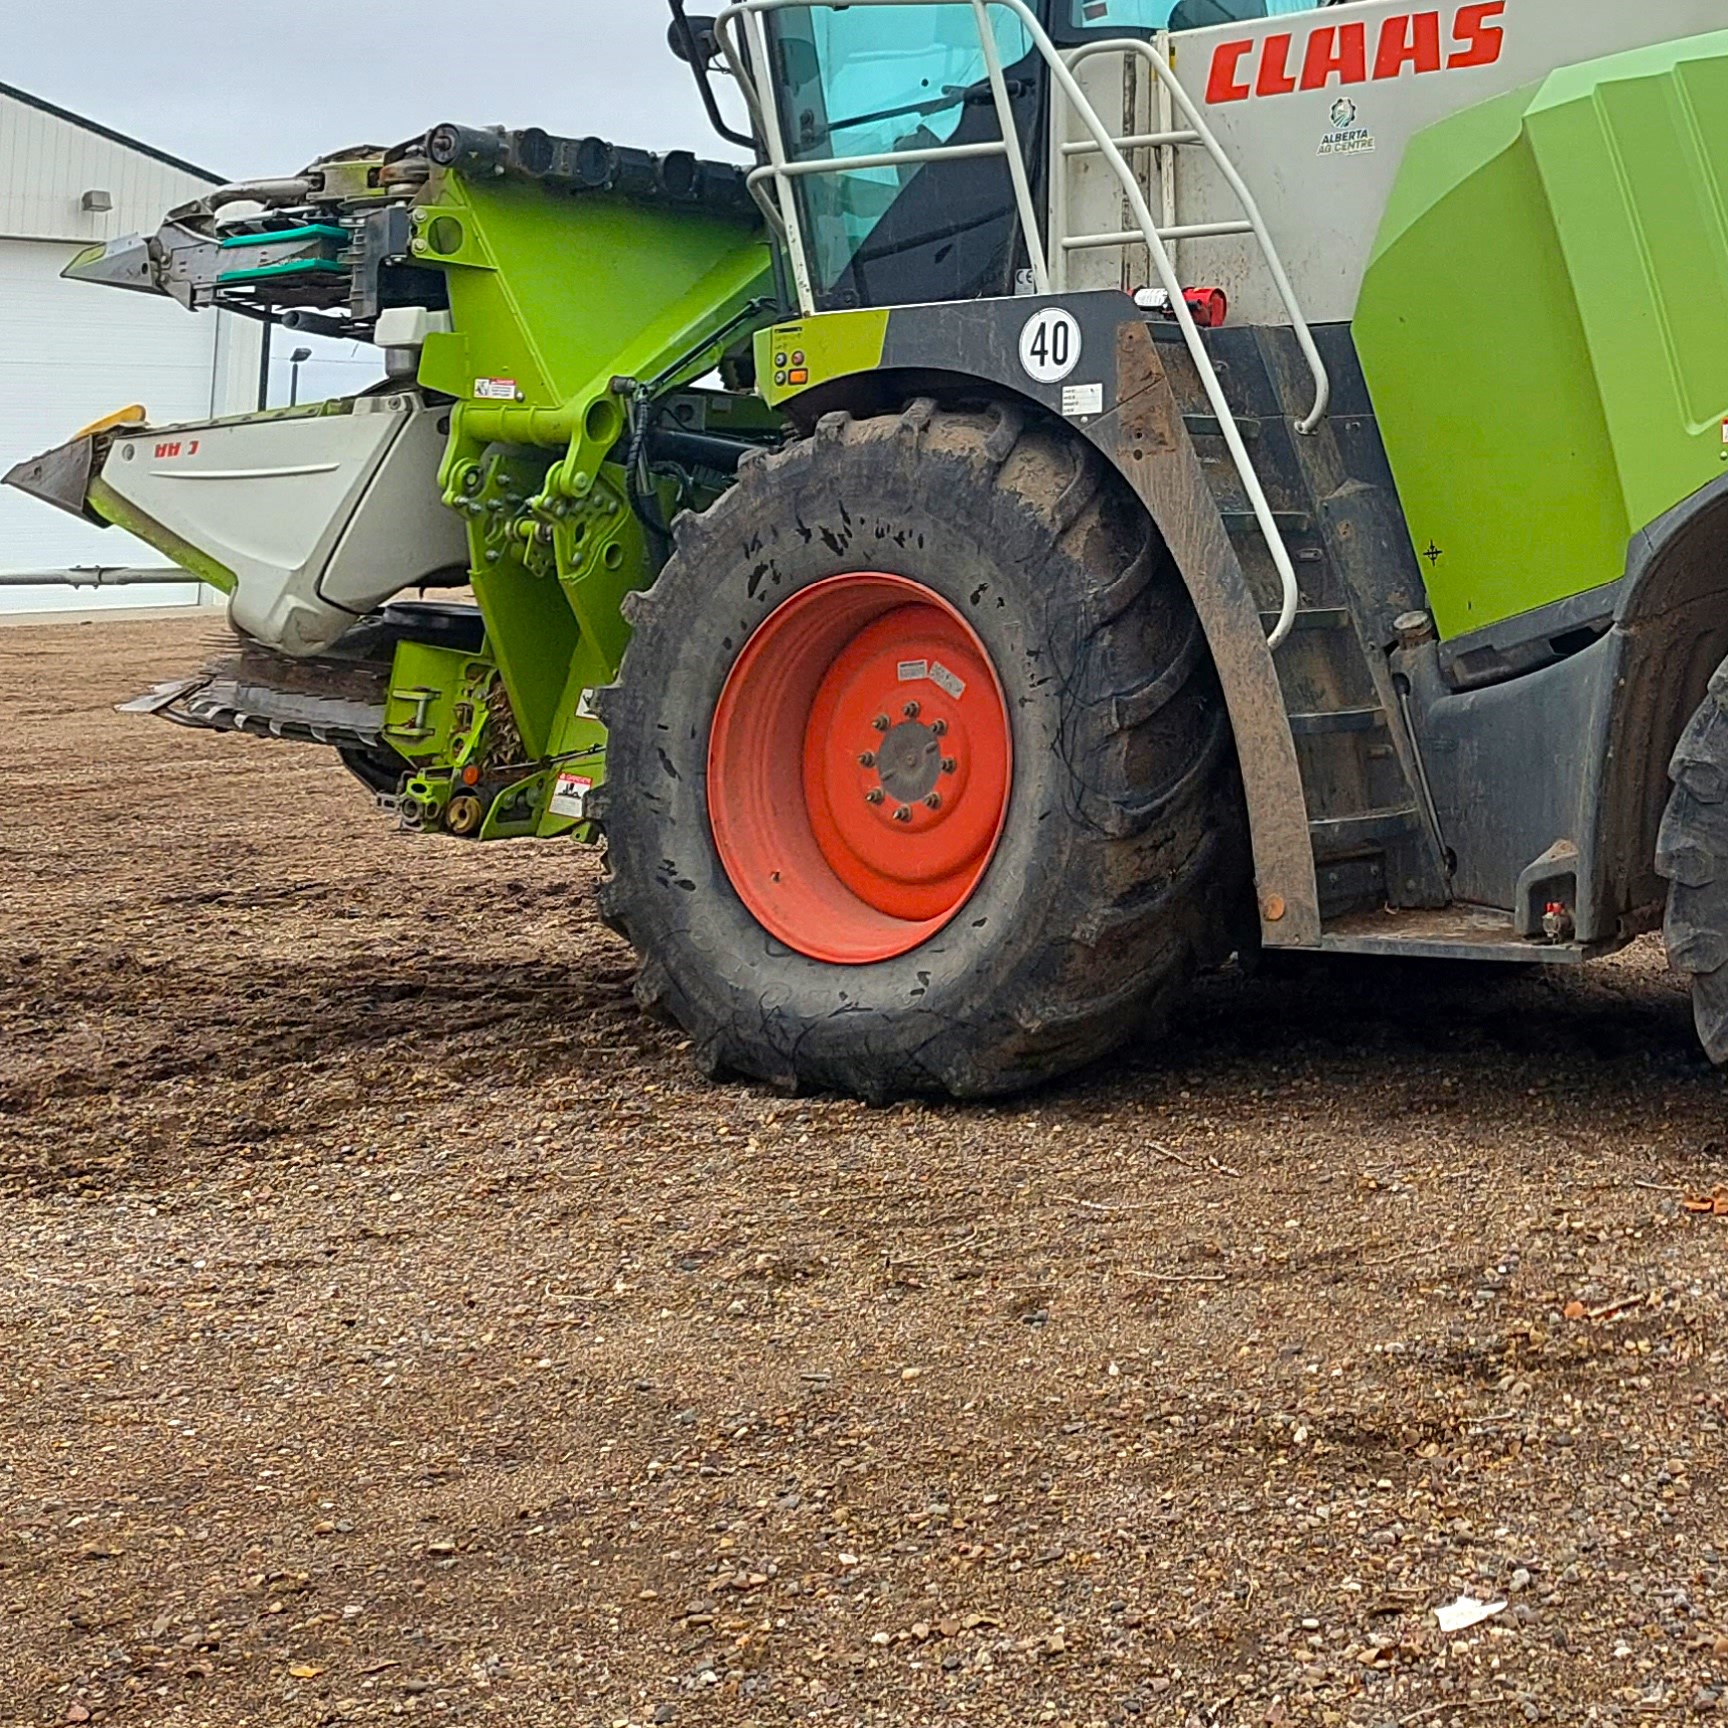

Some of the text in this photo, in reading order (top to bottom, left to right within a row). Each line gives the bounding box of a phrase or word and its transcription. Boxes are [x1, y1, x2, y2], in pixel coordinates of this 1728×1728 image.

[1205, 0, 1506, 105] CLAAS
[1317, 137, 1374, 154] AG CENTRE
[1321, 129, 1368, 144] ALBERTA
[1029, 320, 1069, 367] 40
